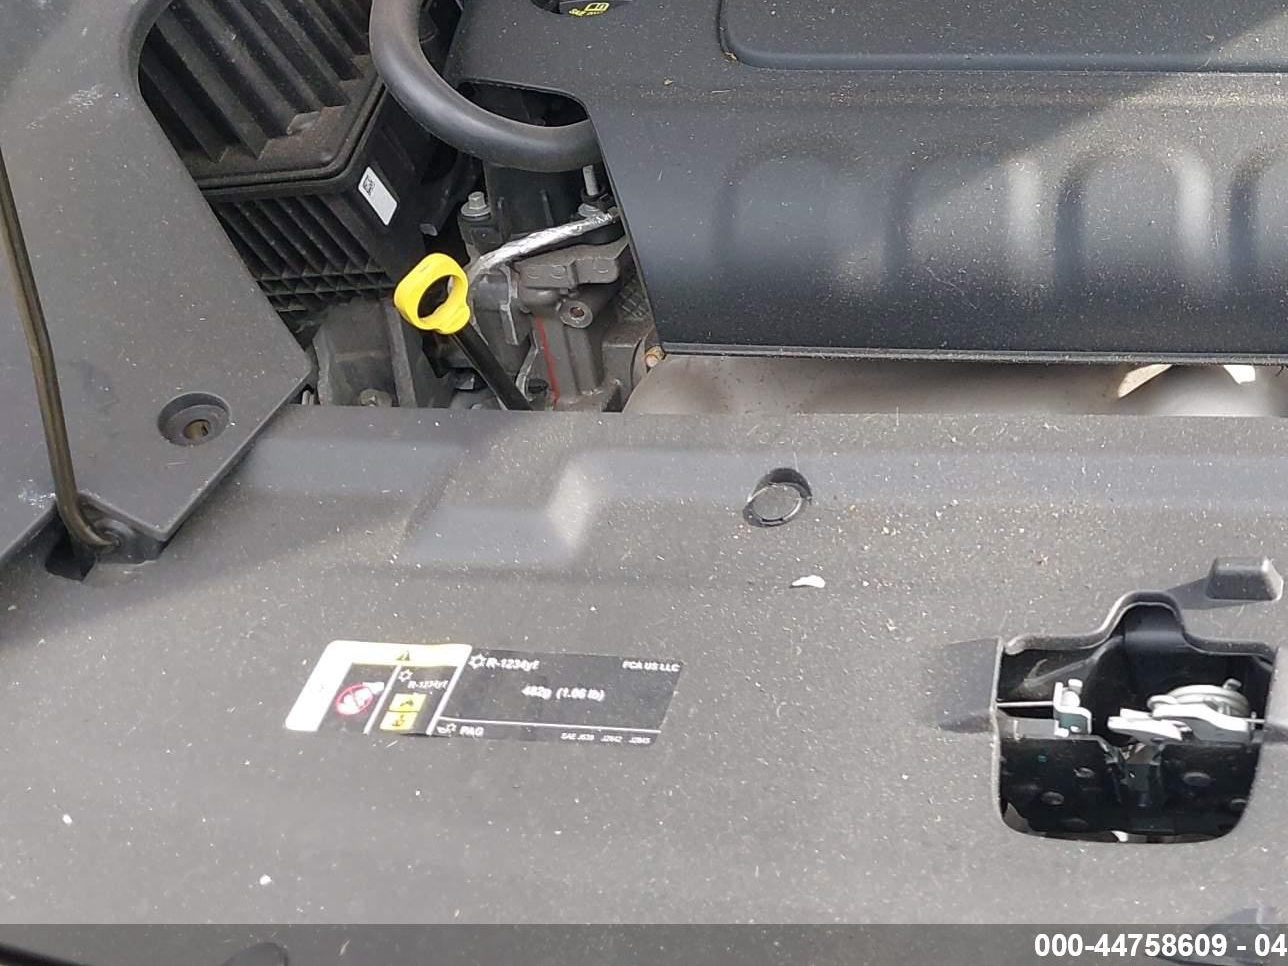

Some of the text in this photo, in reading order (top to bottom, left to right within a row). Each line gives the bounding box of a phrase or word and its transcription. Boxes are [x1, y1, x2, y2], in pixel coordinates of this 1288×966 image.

[622, 660, 643, 670] FCA
[644, 661, 659, 671] US
[659, 662, 681, 672] LLC
